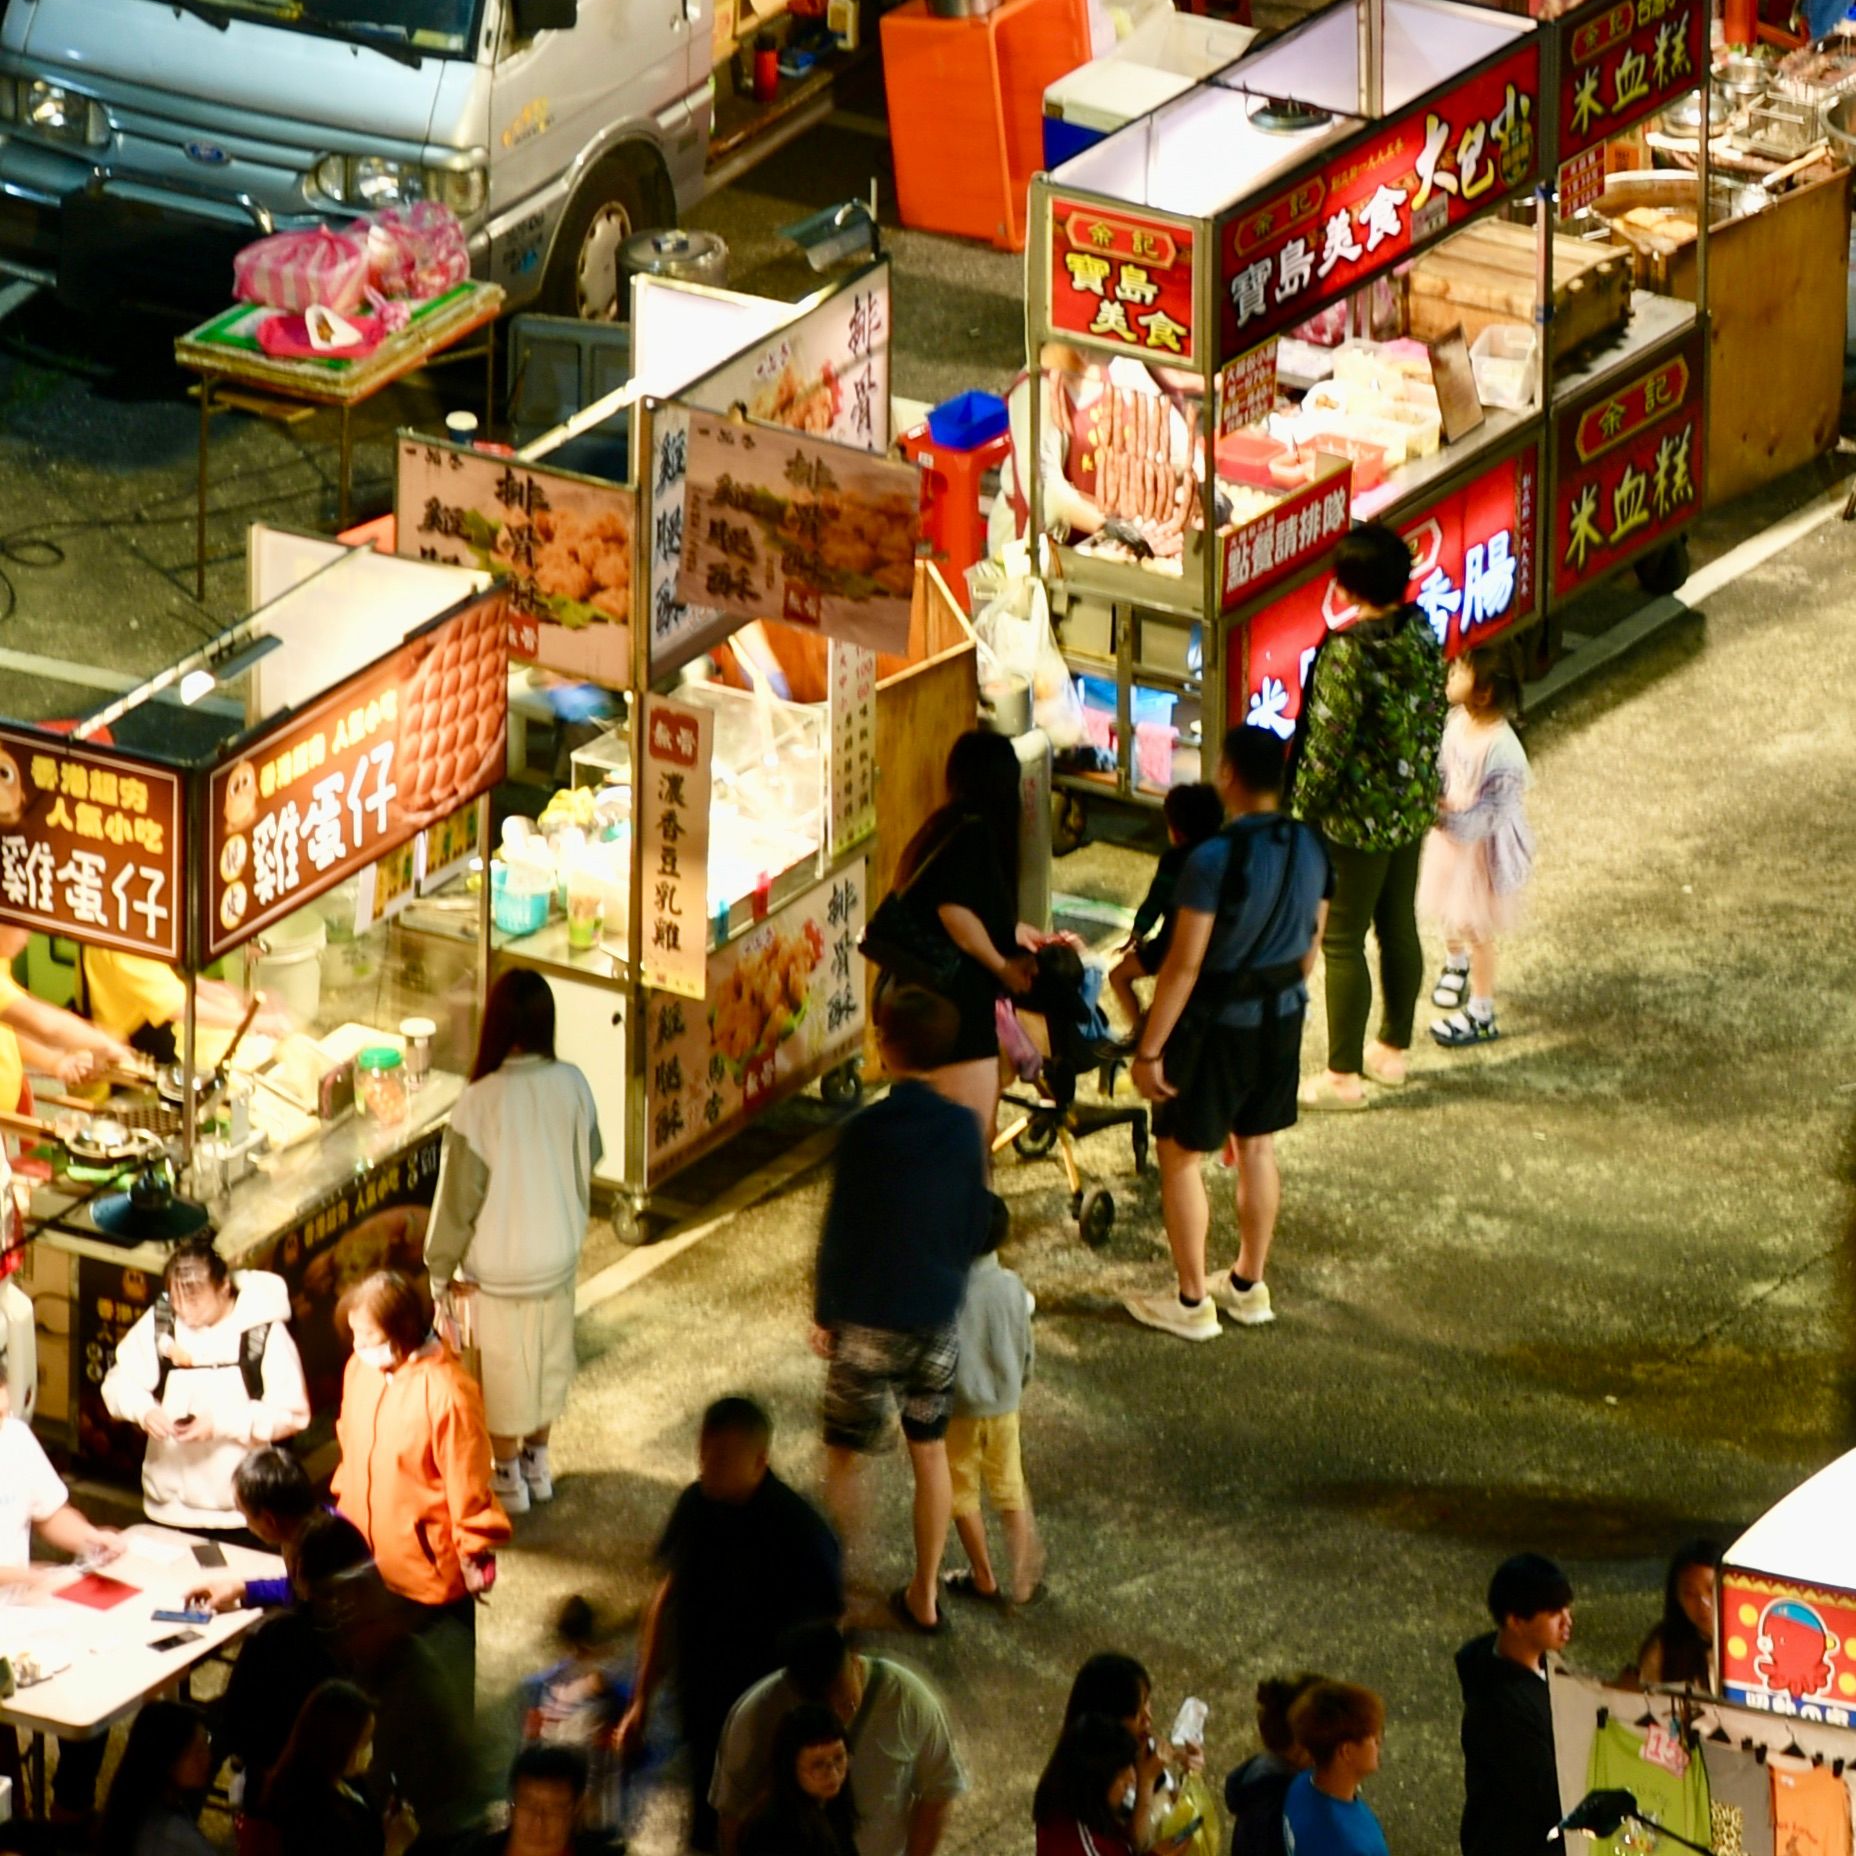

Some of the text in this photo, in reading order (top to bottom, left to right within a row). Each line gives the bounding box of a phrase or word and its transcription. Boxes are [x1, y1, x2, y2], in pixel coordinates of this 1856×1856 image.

[1569, 9, 1692, 136] 米血糕
[1066, 251, 1159, 306] 寶島
[1231, 184, 1408, 328] 寶島美食
[848, 290, 882, 452] 排骨
[1089, 298, 1188, 353] 美食
[1226, 484, 1347, 593] 點餐請排隊
[1564, 423, 1694, 570] 米血糕
[31, 754, 149, 814] 香港超夯
[45, 796, 164, 855] 人氣小吃
[252, 739, 397, 906] 雞蛋仔
[1, 834, 169, 940] 雞蛋仔
[653, 770, 688, 954] 濃香豆乳雞
